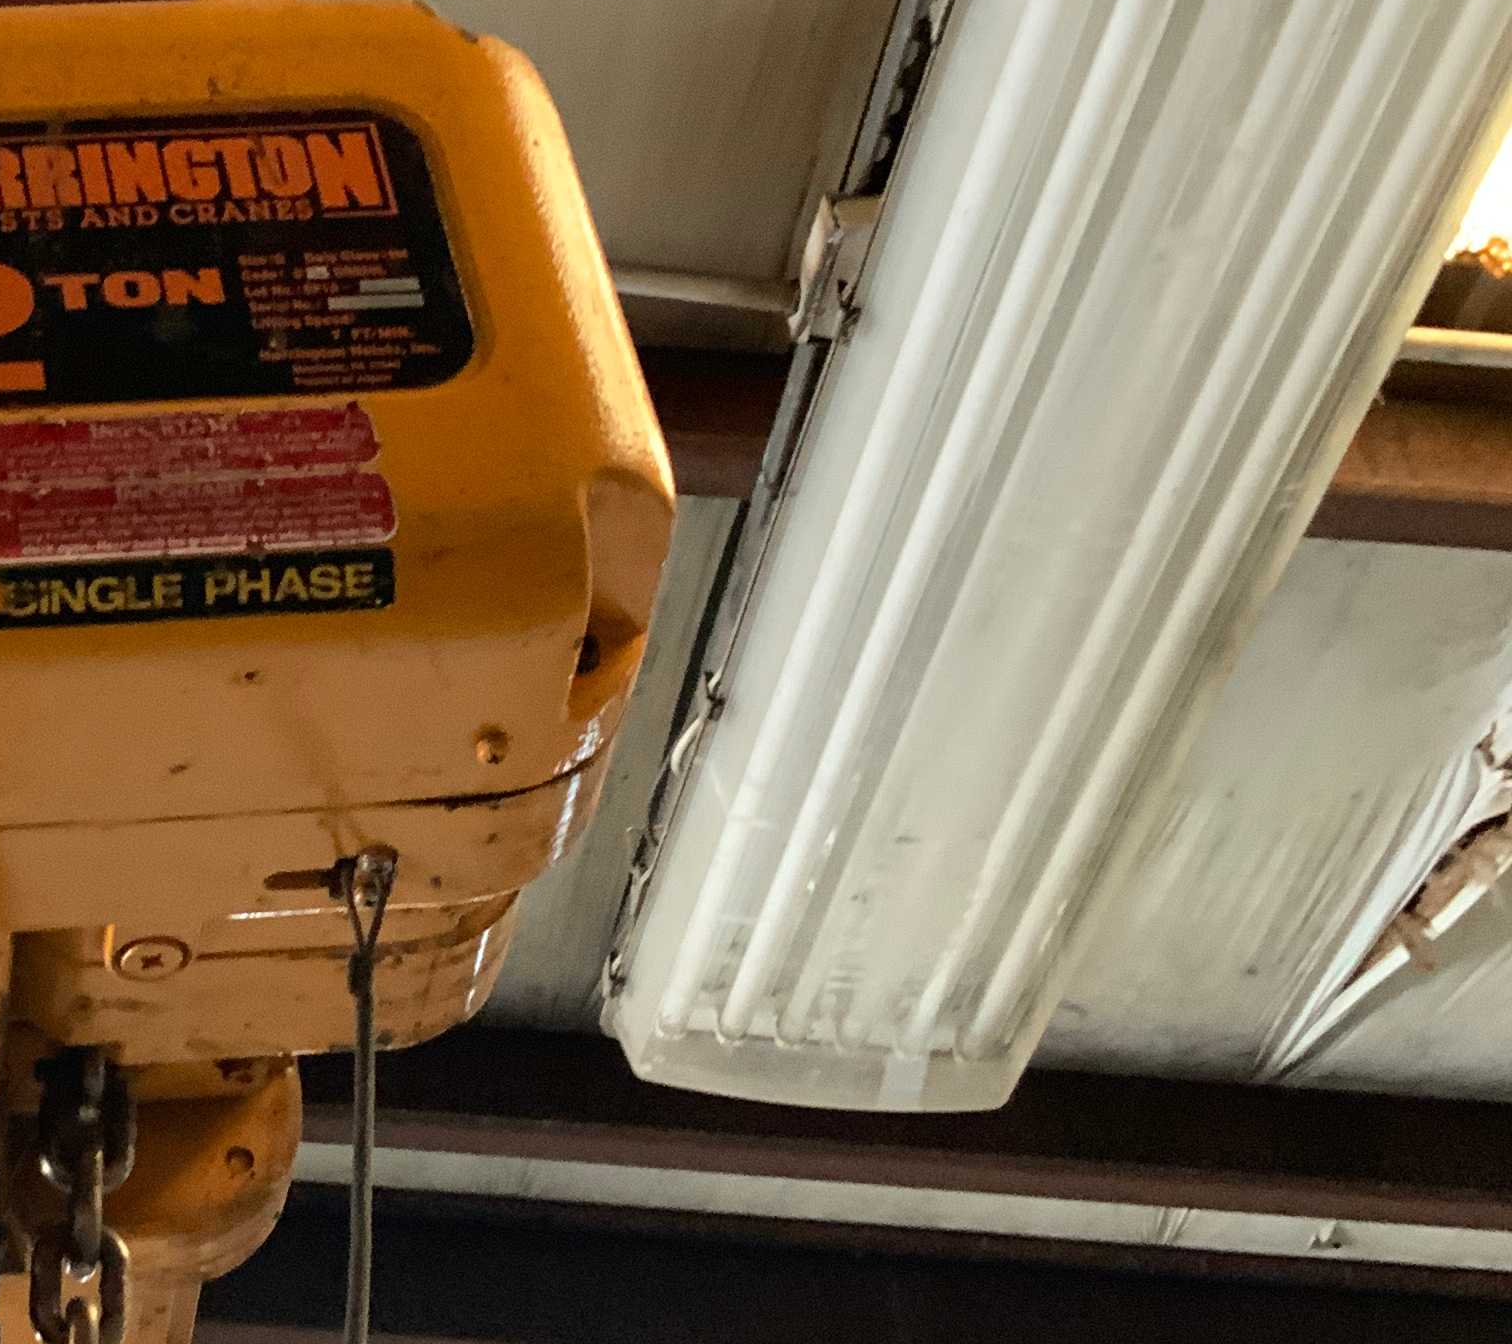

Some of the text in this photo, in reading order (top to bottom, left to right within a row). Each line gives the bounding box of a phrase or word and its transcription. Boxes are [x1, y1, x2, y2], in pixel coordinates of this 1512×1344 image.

[79, 205, 159, 229] AND
[168, 200, 314, 226] CRANES
[44, 268, 226, 312] TON
[203, 562, 376, 606] PHASE
